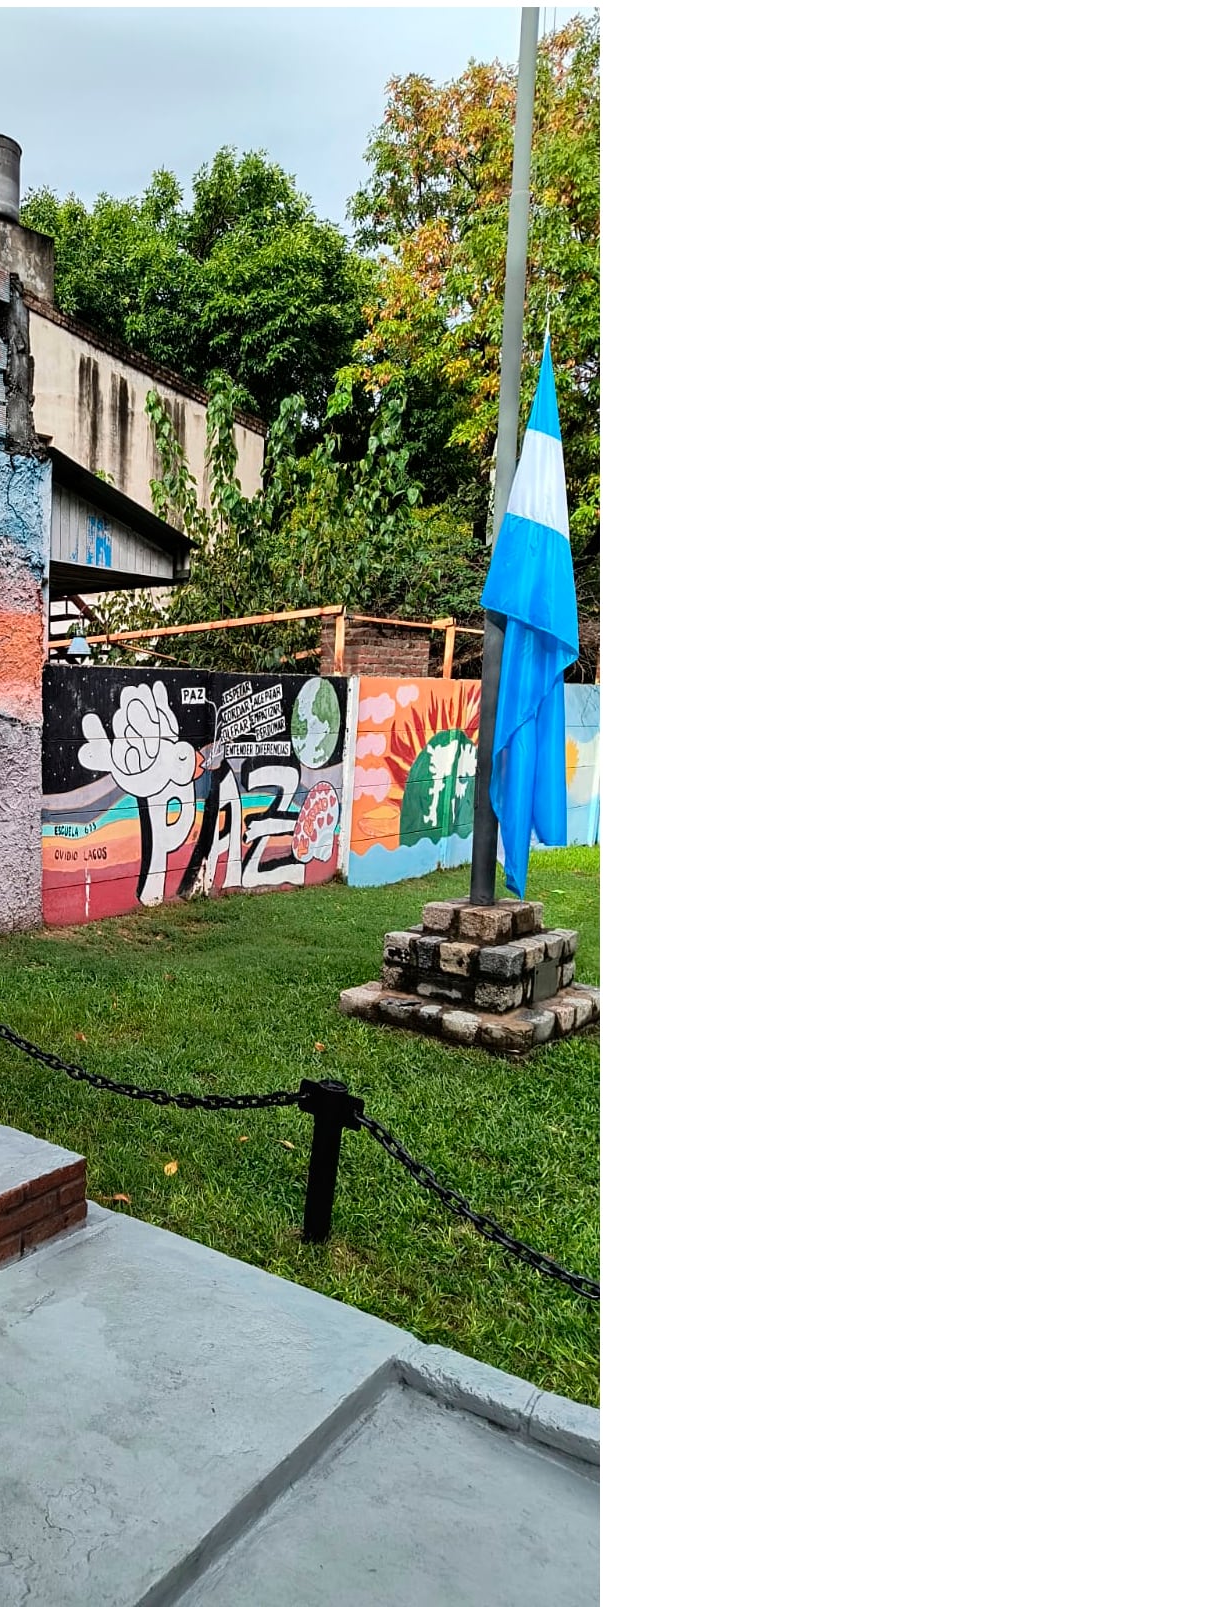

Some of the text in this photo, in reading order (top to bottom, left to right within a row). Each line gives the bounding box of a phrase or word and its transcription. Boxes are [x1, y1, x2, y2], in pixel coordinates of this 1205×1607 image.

[183, 690, 203, 701] PAZ
[253, 686, 281, 706] ACEPTAR
[249, 704, 281, 726] EMPATIZAR
[256, 719, 285, 740] PERDONAR
[226, 743, 289, 756] ENTENDER DIFERENCIAS
[55, 826, 79, 837] ESCUELA
[139, 764, 305, 907] PAZ
[55, 846, 107, 861] OVIDIO LAGOS
